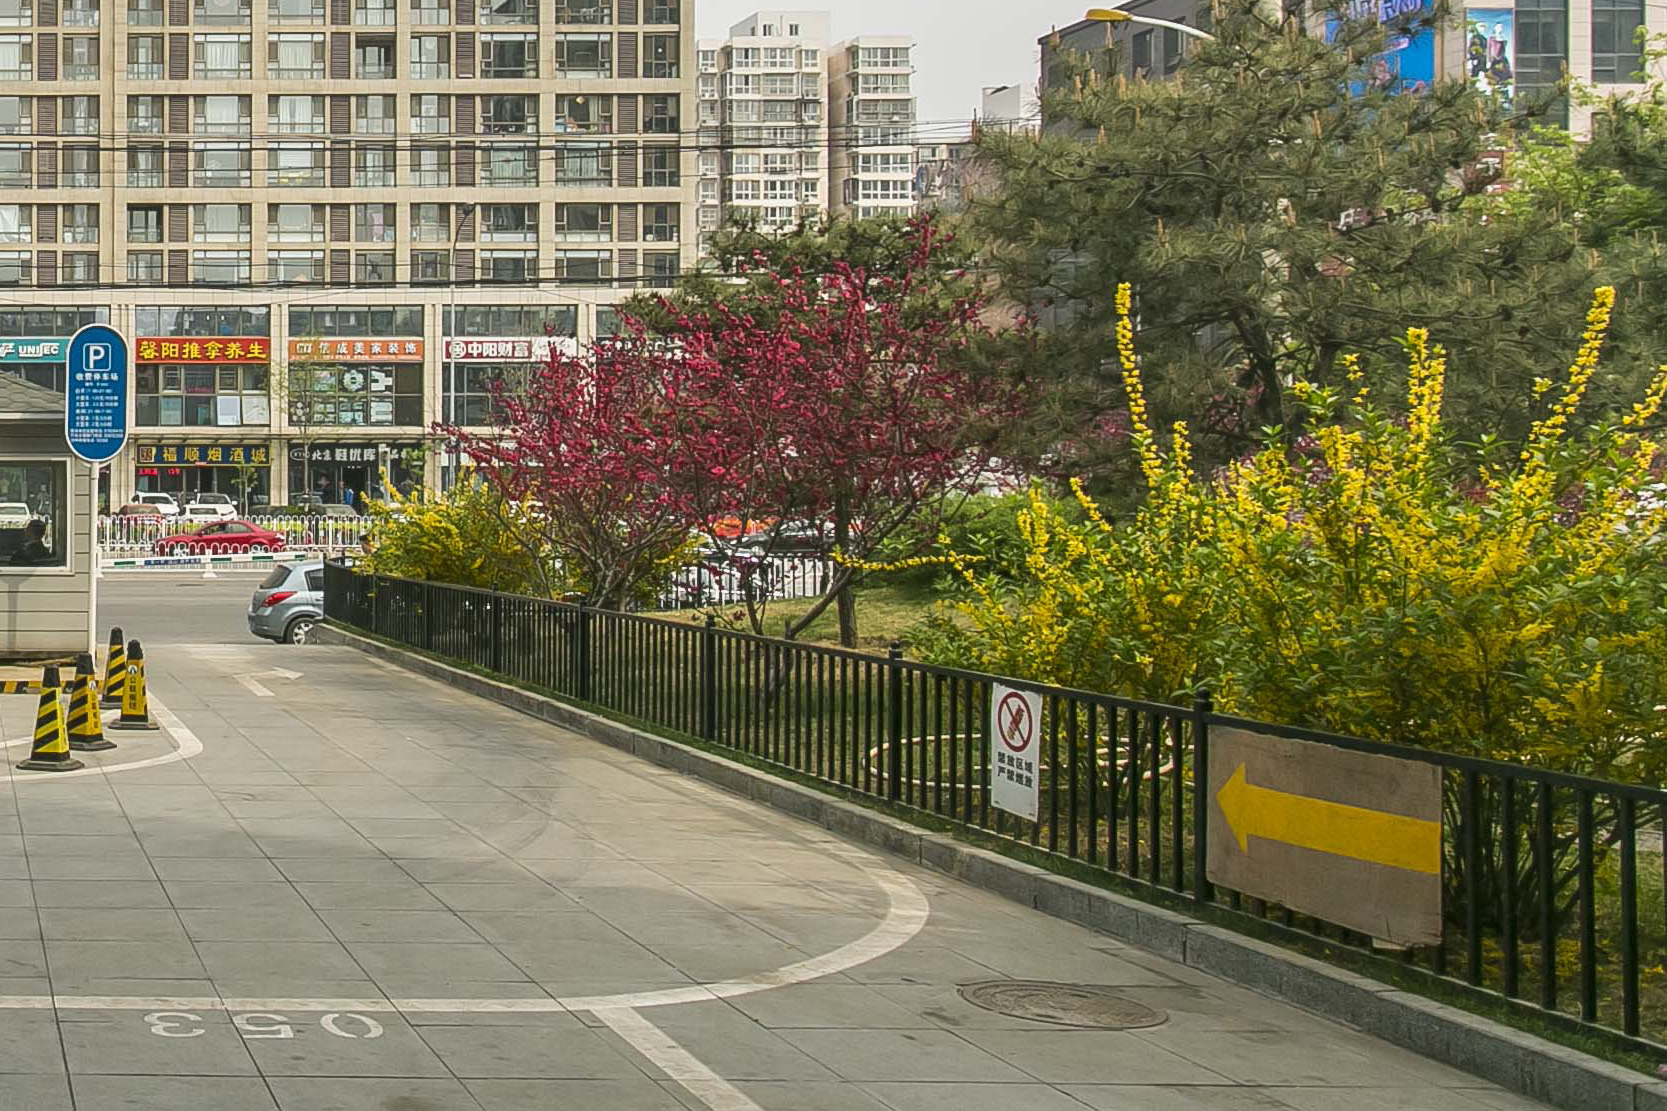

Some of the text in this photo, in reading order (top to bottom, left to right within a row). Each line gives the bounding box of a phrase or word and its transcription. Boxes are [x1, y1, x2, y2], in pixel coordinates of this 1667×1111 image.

[89, 345, 105, 369] P
[139, 340, 267, 359] 馨阳推拿养生
[467, 341, 529, 358] 中阳财富
[162, 446, 267, 462] 福顺烟酒城
[142, 1011, 385, 1041] 053
